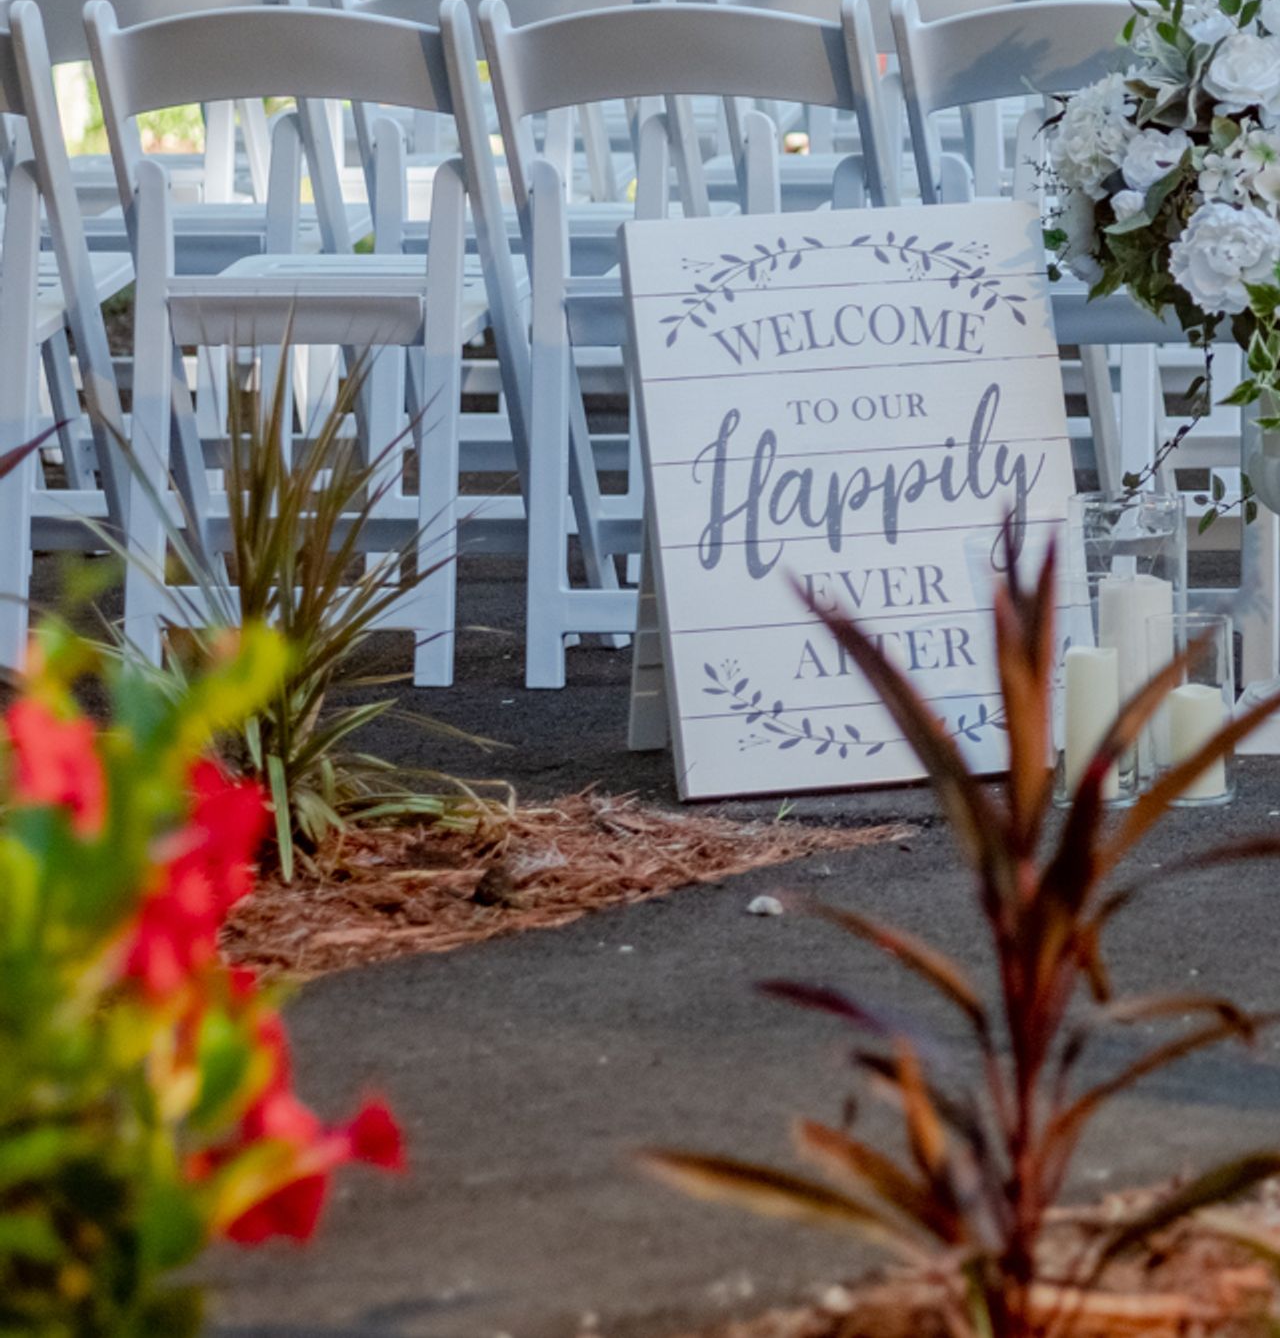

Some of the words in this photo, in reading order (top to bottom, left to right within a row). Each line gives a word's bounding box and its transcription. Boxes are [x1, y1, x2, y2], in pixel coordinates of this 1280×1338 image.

[711, 304, 985, 365] WELCOME
[787, 399, 838, 425] TO
[851, 393, 928, 419] OUR
[692, 382, 1045, 580] Happily
[802, 564, 951, 613] EVER
